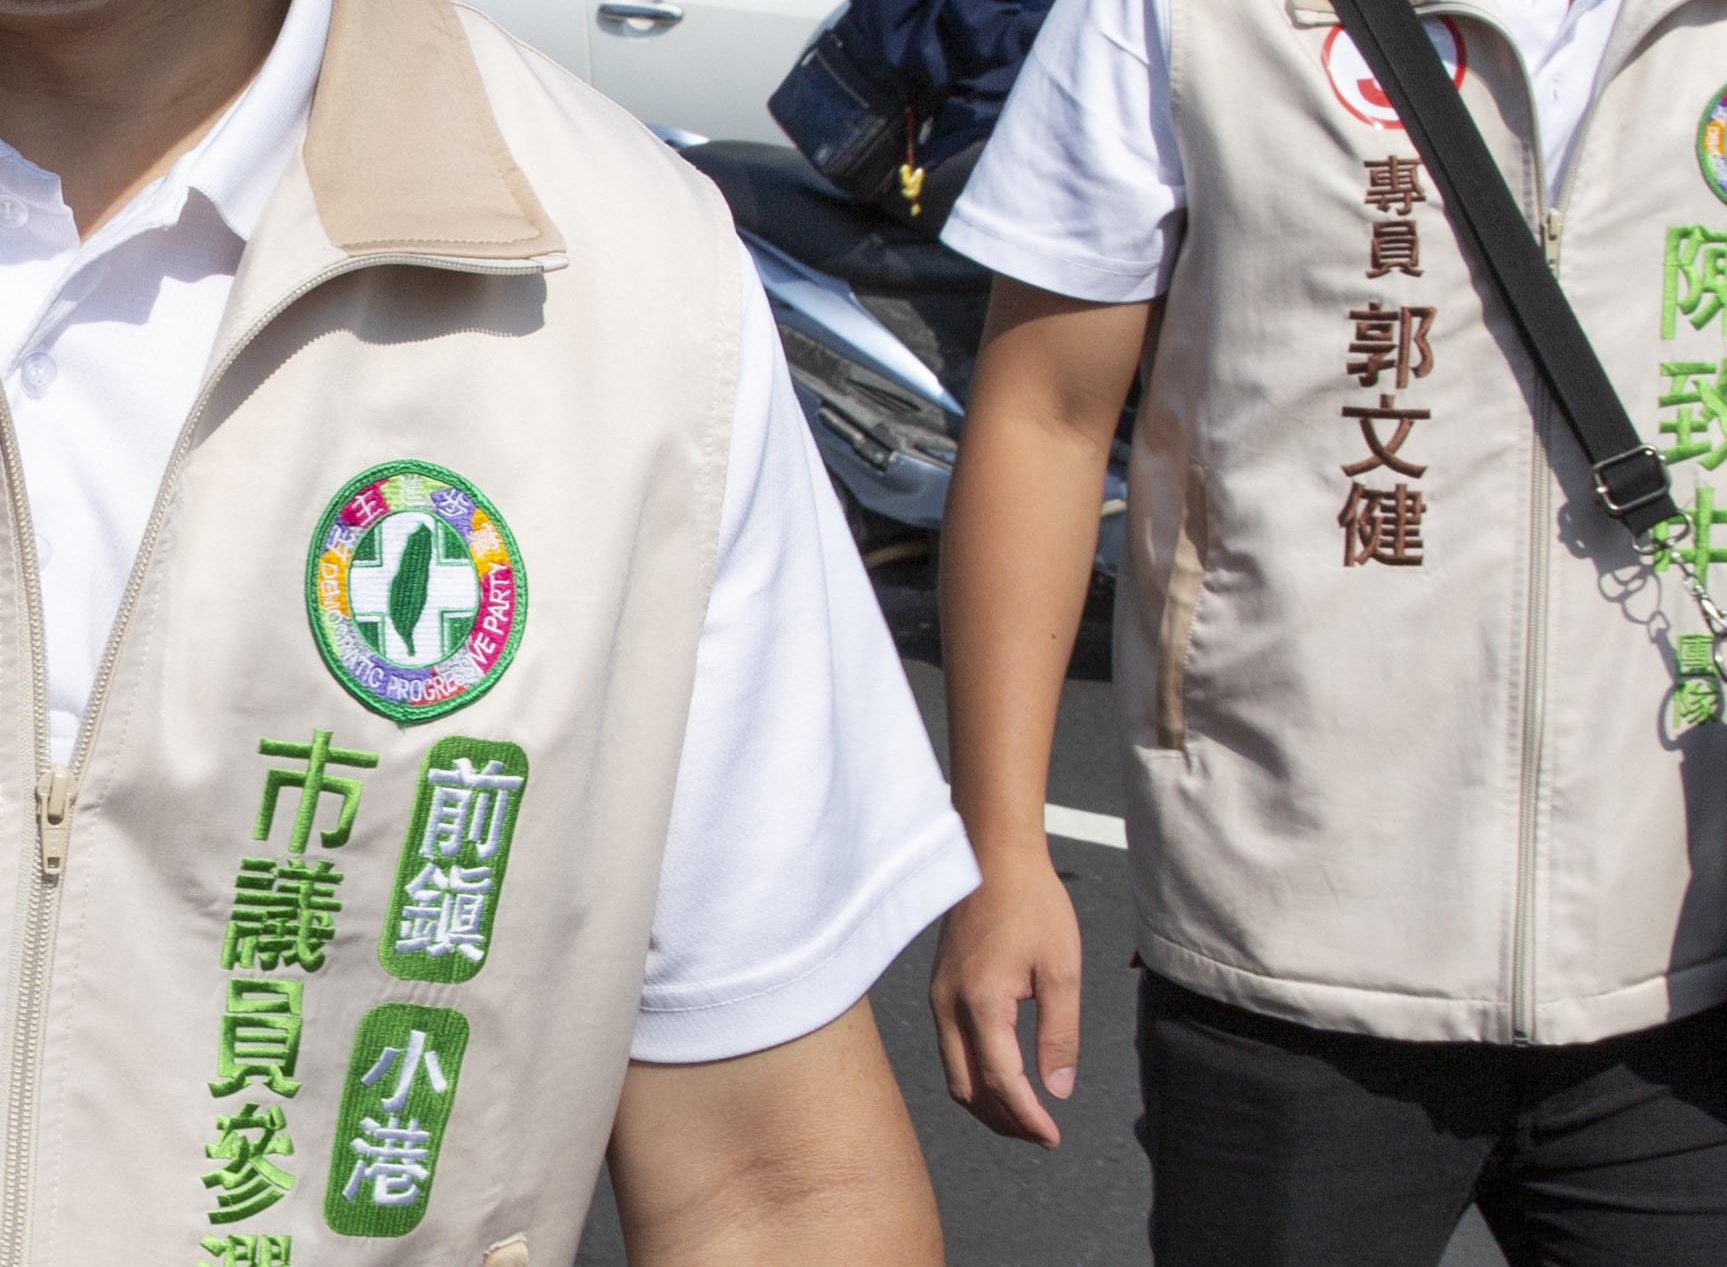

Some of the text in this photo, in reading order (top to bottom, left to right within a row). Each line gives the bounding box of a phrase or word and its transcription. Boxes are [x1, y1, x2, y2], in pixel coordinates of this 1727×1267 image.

[1363, 154, 1427, 279] 專員
[1337, 300, 1438, 568] 郭文健
[318, 561, 512, 704] DEMOCRATIC PROGRESSIVE PARTY
[341, 1029, 450, 1208] 小港
